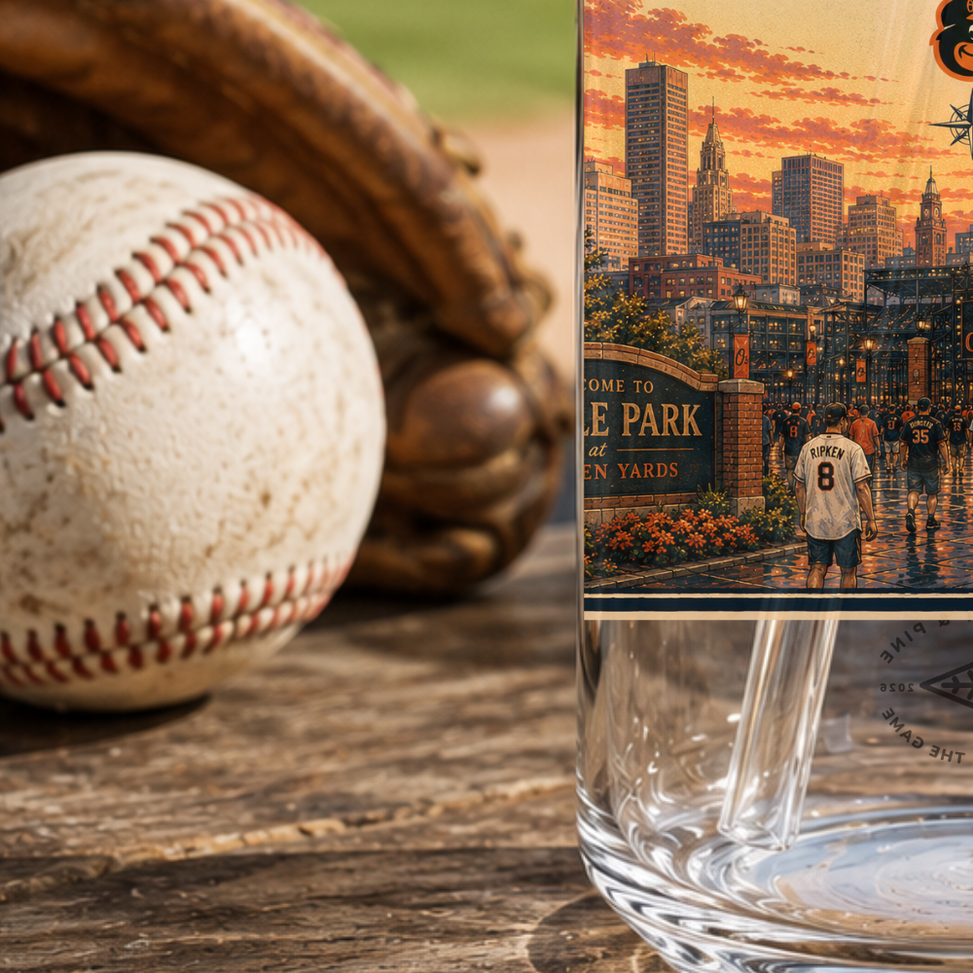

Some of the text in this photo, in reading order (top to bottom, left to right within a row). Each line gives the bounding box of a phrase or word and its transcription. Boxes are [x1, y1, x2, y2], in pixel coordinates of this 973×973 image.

[633, 380, 654, 394] TO
[621, 402, 703, 437] PARK
[912, 429, 929, 444] 35
[588, 442, 608, 457] at
[809, 445, 846, 461] RIPKEN
[617, 462, 679, 479] YARDS
[817, 461, 835, 492] 8
